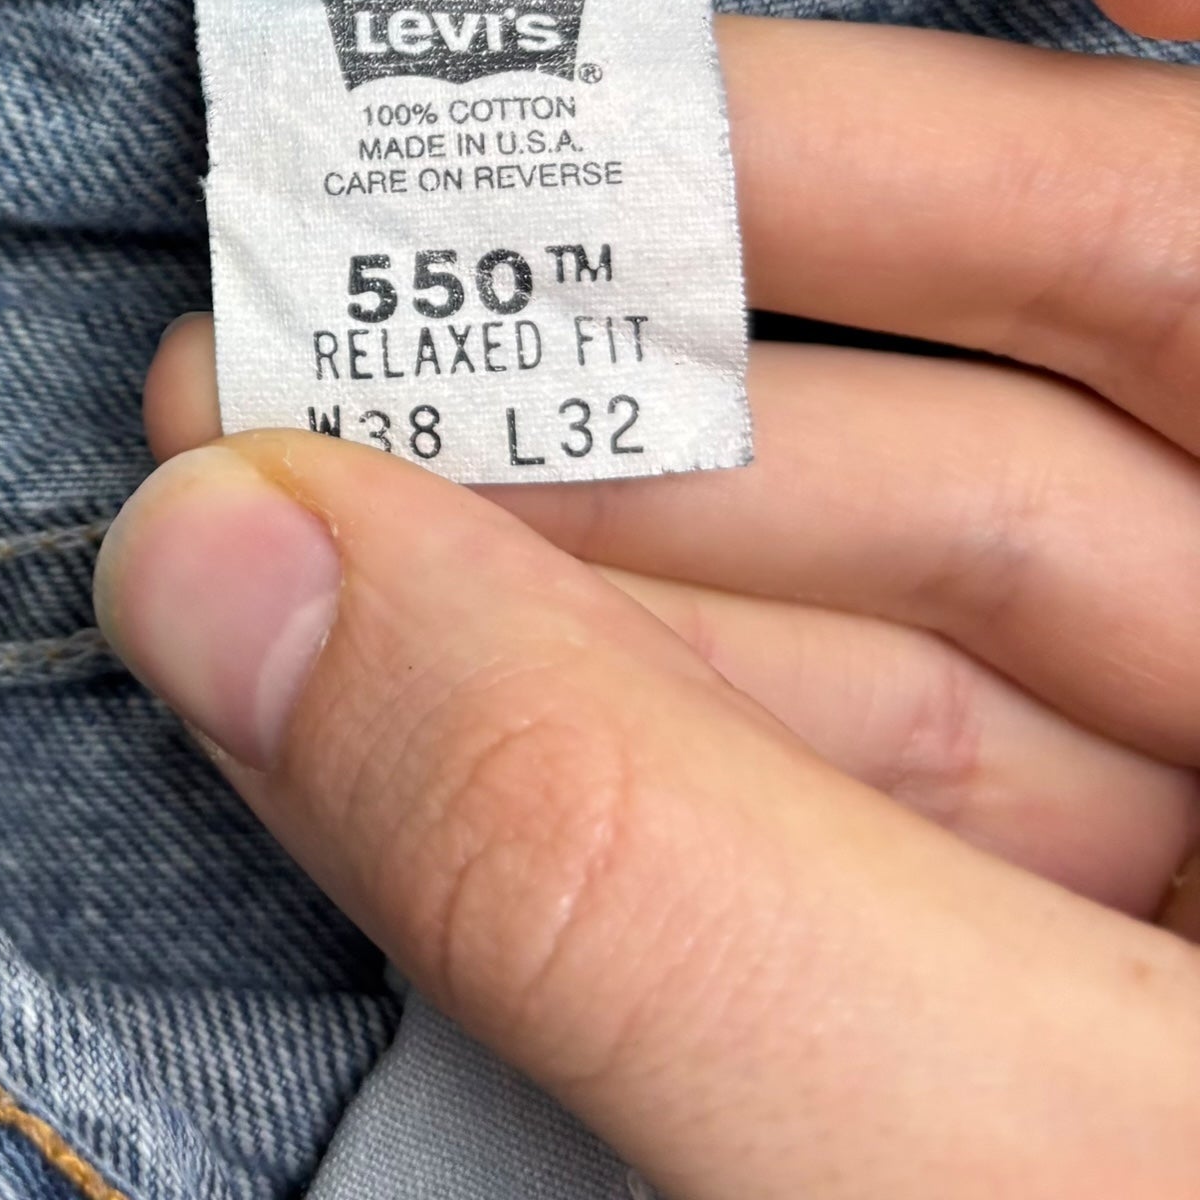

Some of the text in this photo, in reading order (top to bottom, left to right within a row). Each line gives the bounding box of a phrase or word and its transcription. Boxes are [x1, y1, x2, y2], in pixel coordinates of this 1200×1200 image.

[362, 97, 577, 127] 100% COTTON
[359, 130, 584, 161] MADE IN U.S.A.
[324, 162, 624, 196] CARE ON REVERSE
[313, 315, 649, 380] RELAXED FIT
[506, 394, 645, 467] L32
